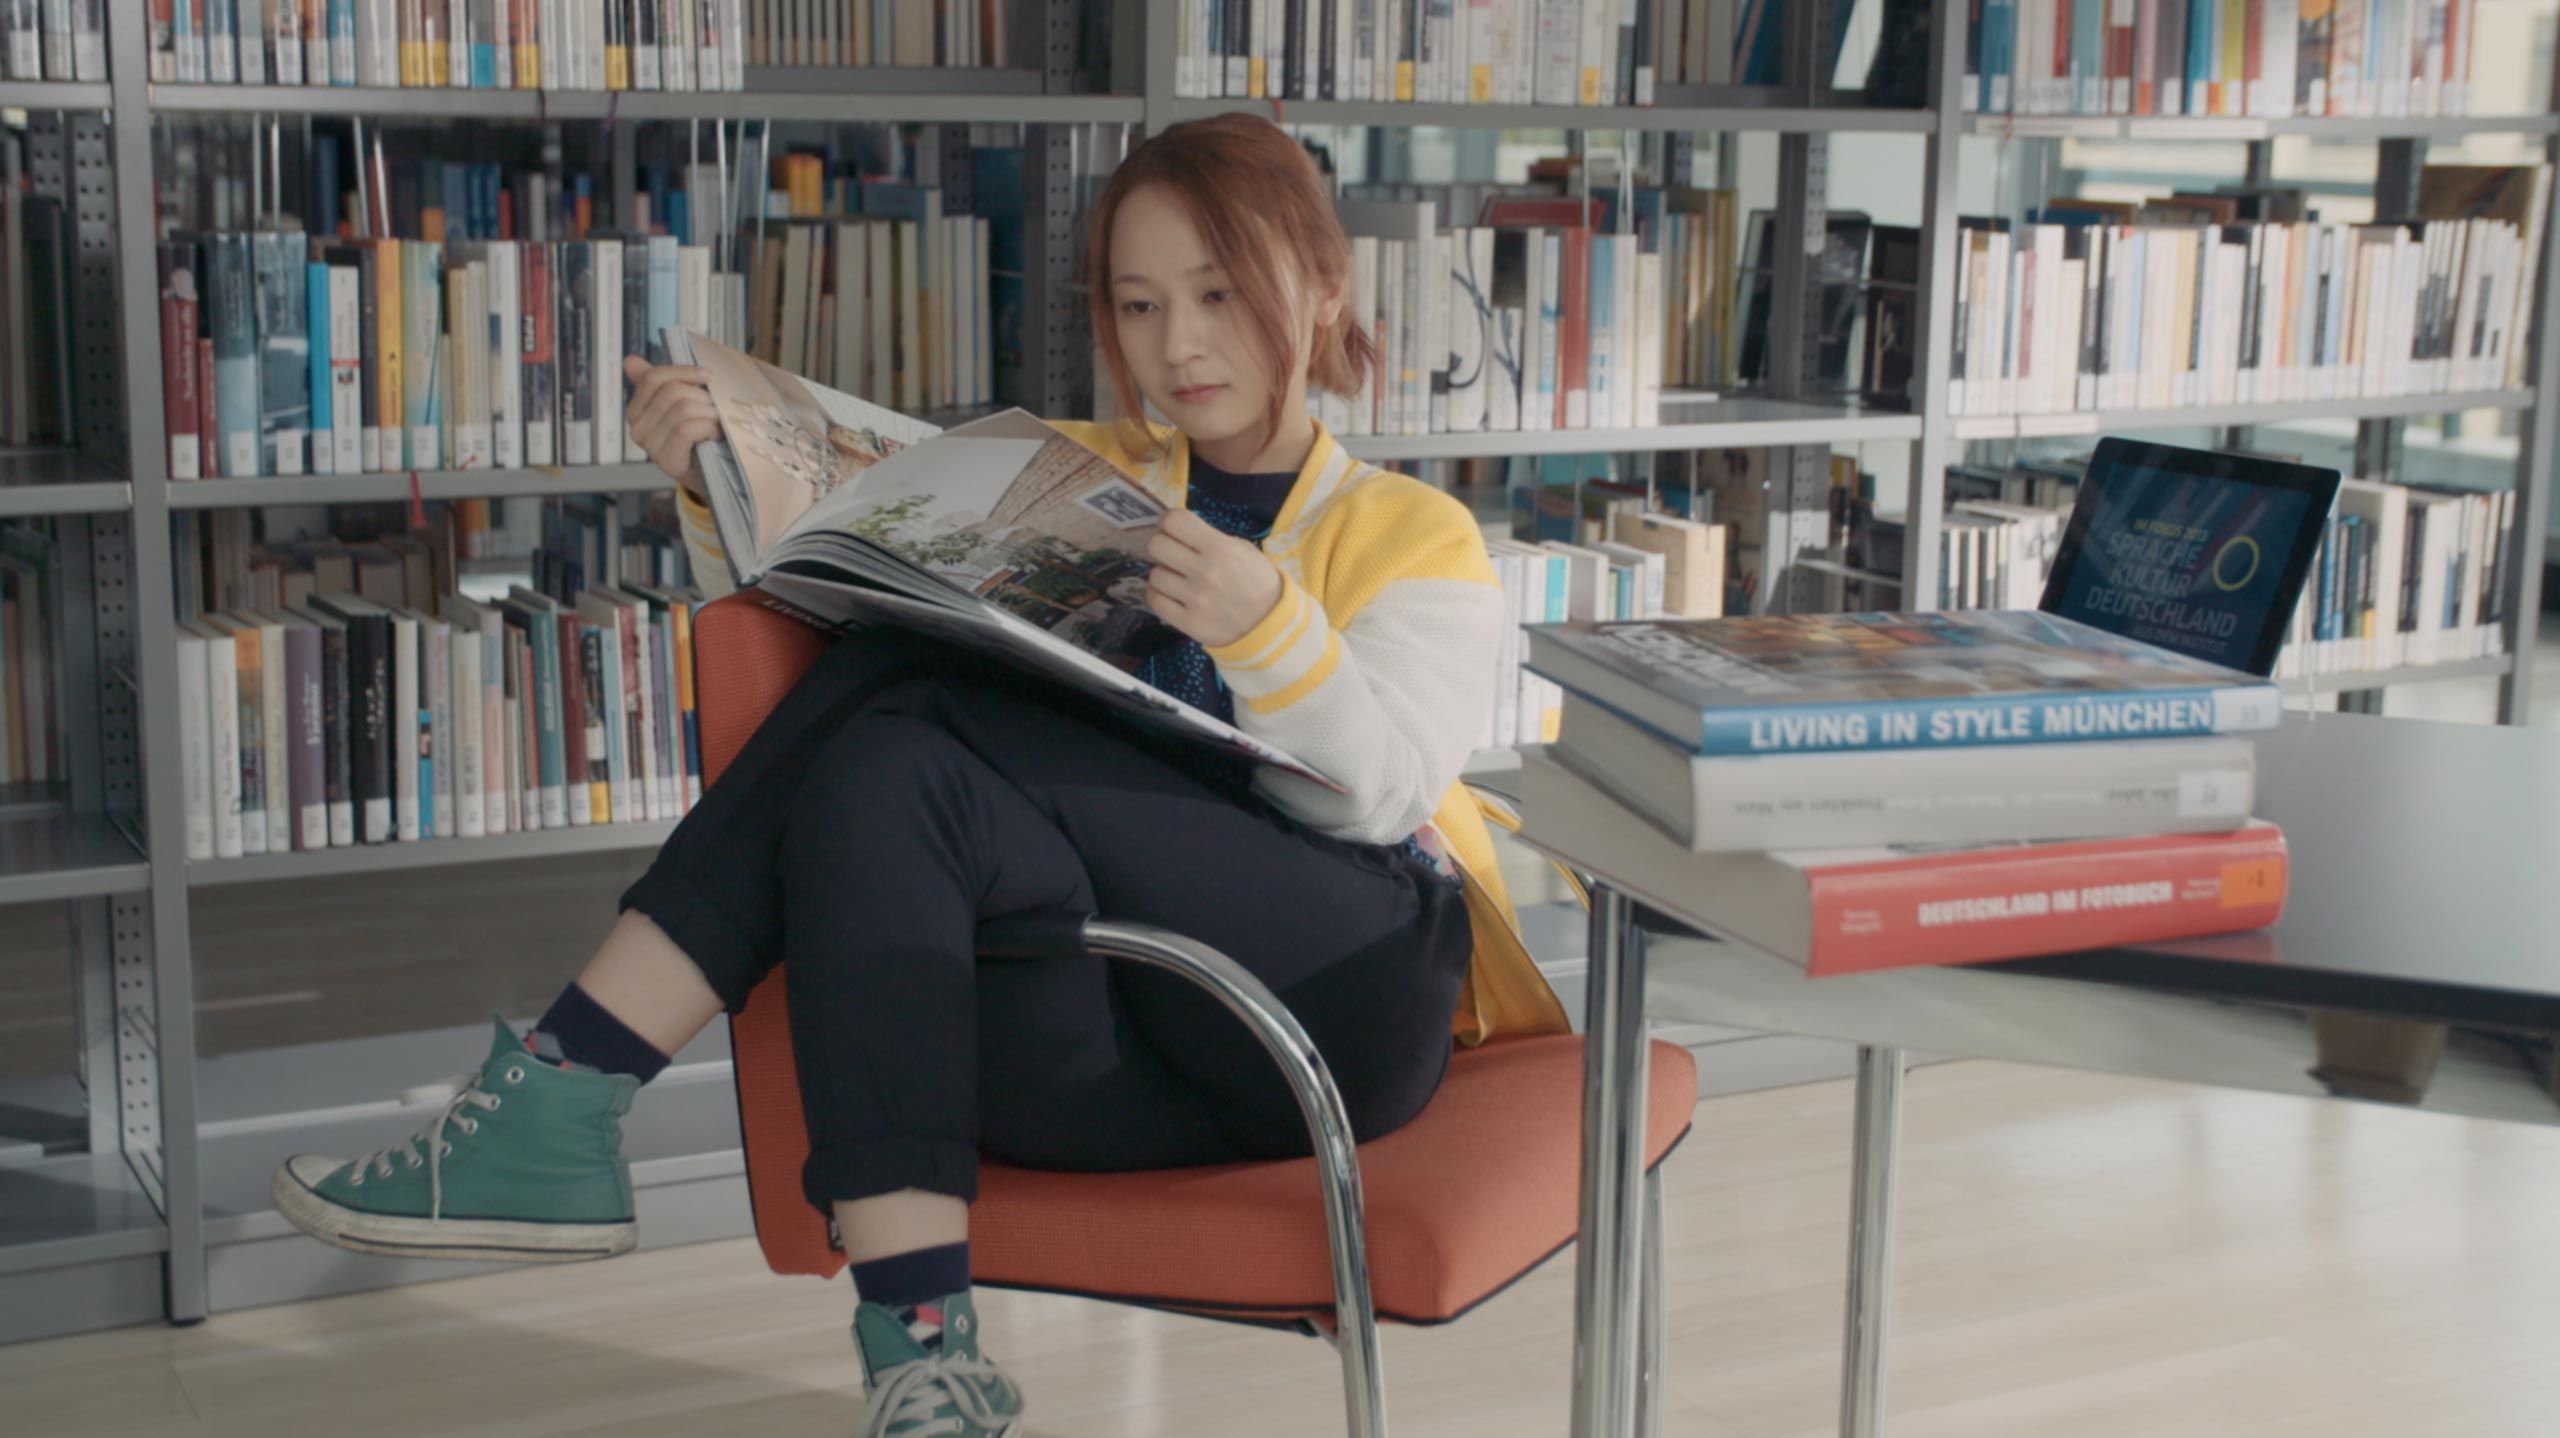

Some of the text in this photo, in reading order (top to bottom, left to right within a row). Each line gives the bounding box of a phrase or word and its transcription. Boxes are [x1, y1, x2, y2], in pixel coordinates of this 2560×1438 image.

[2105, 531, 2203, 570] SPRACHE
[2148, 520, 2183, 539] FOKUS
[2109, 561, 2192, 598] KULTUR
[2085, 586, 2238, 638] DEUTSCHLAND
[1751, 713, 1869, 749] LIVING
[1880, 712, 1917, 742] IN
[1930, 706, 2032, 741] STYLE
[2043, 696, 2213, 738] MÜNCHEN
[1918, 892, 2048, 928] DEUTSCHLAND
[2053, 888, 2078, 913] IM
[2080, 880, 2173, 911] FOTOBUCH
